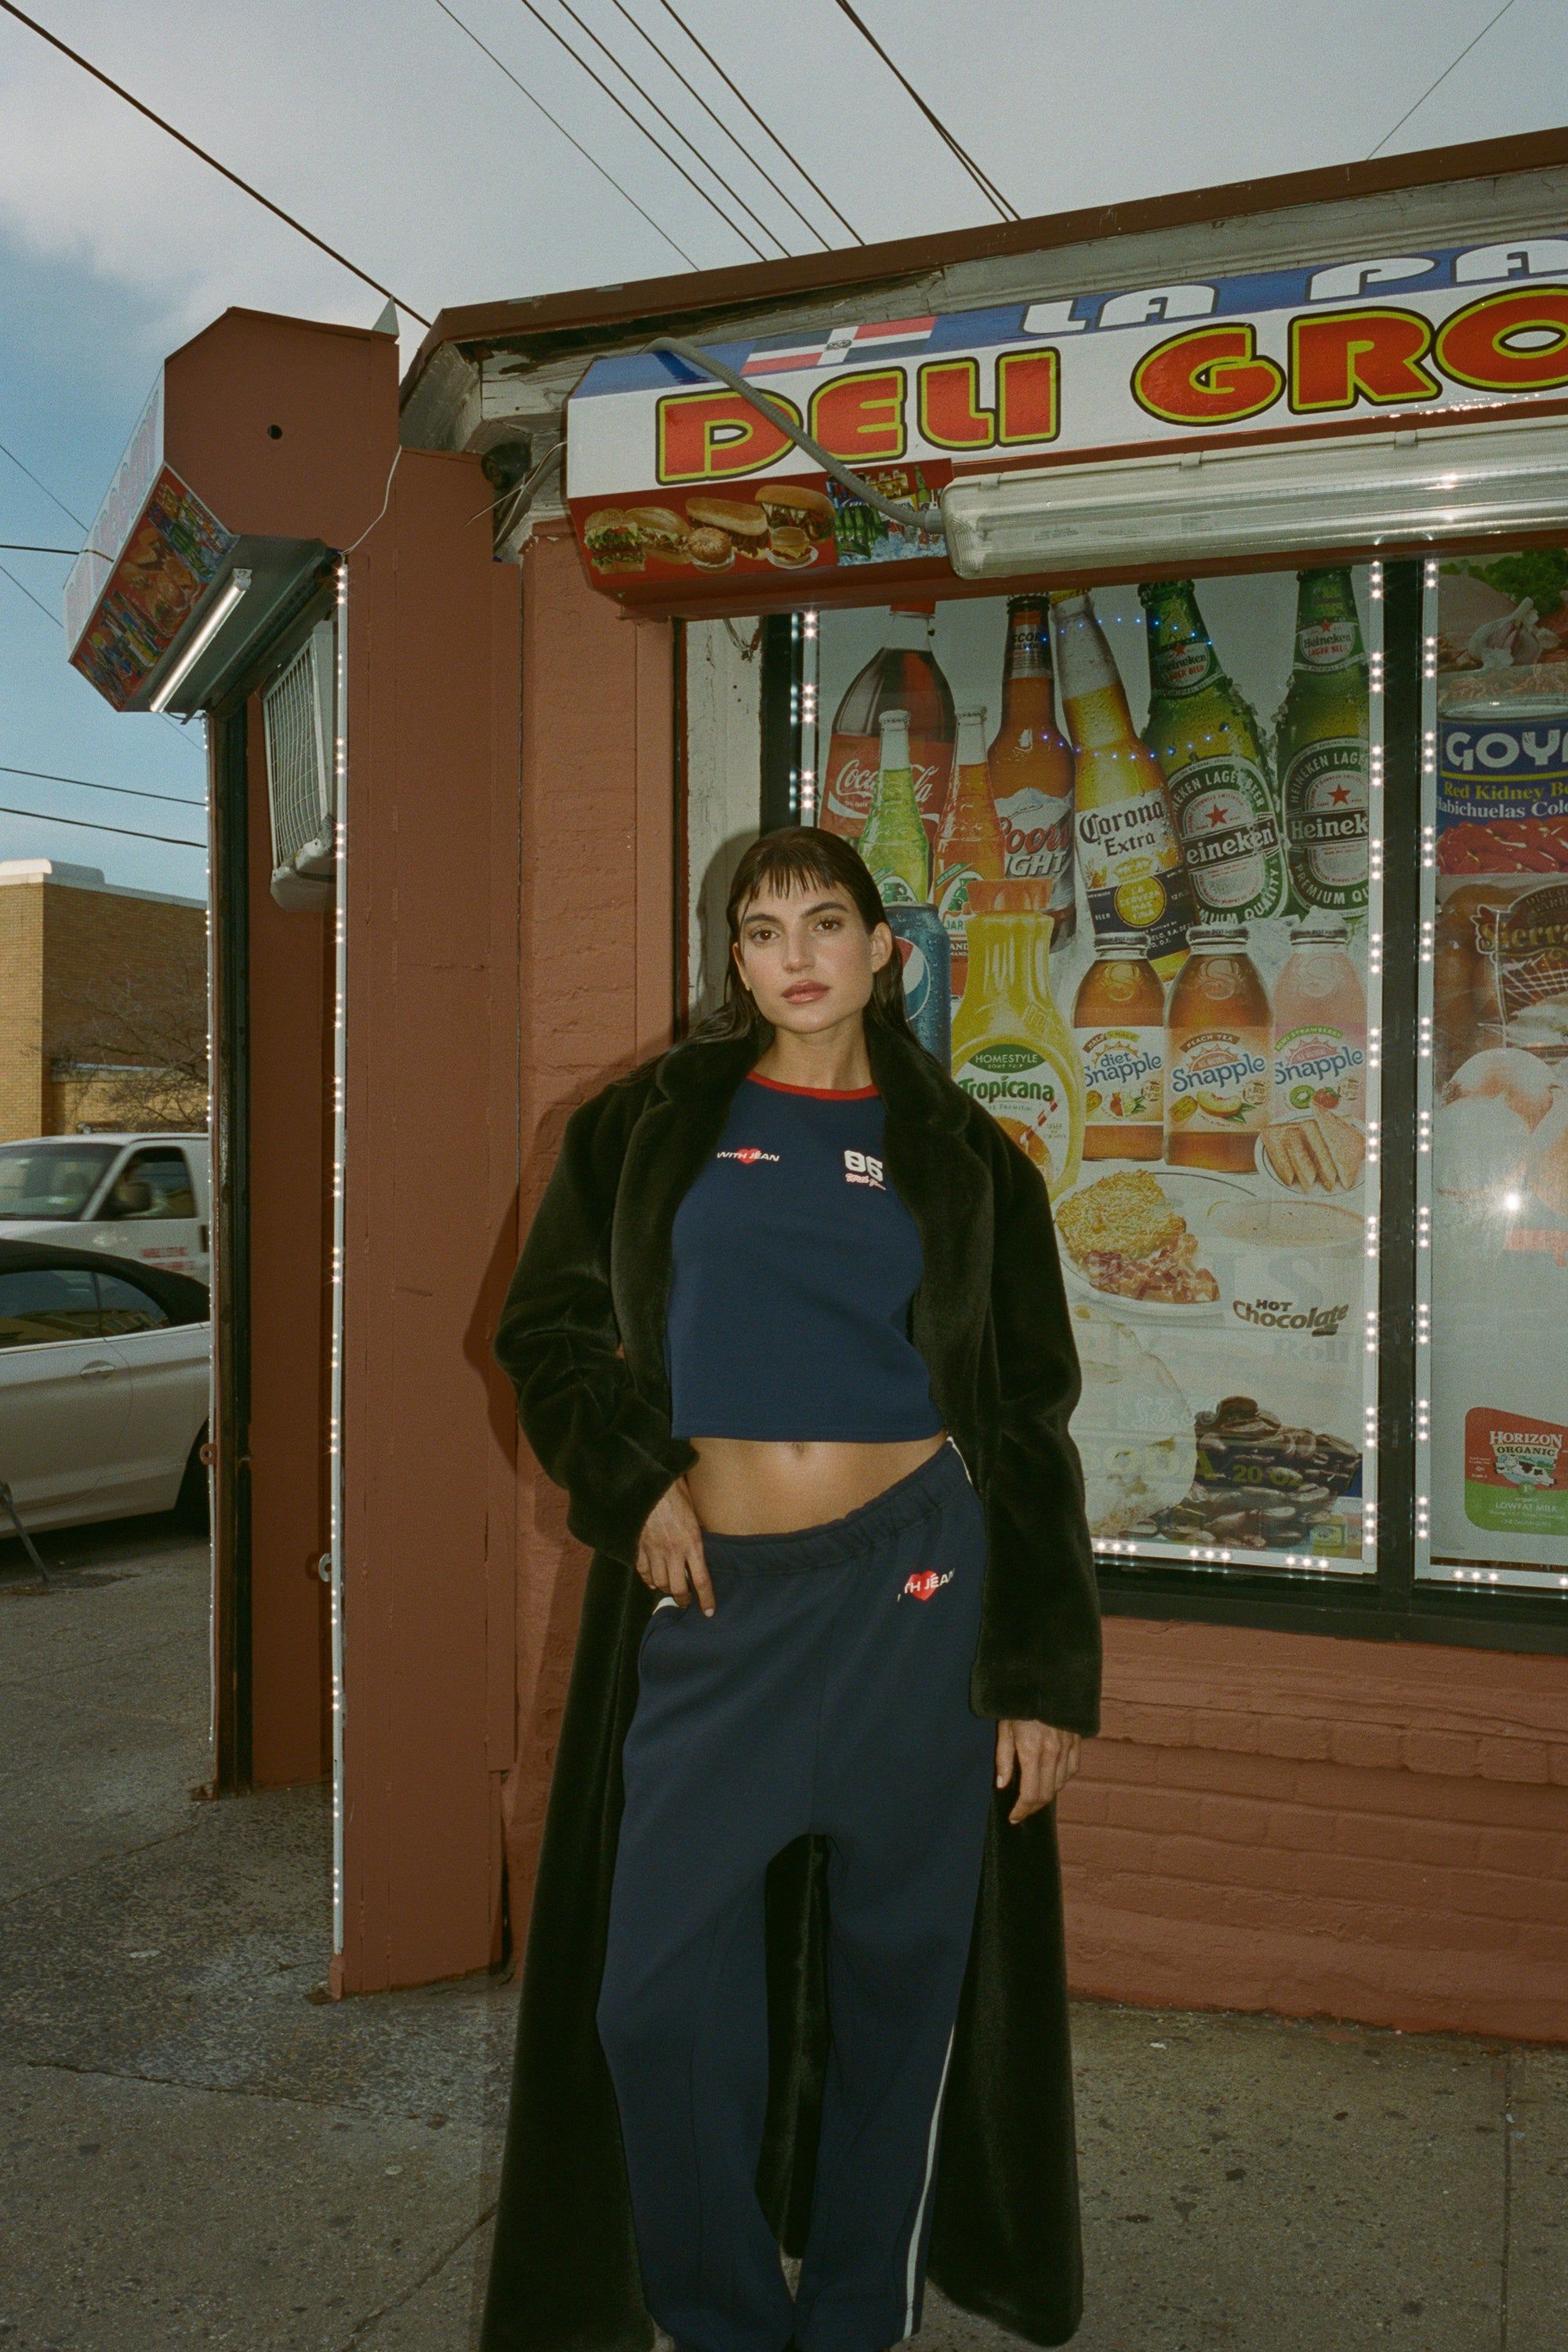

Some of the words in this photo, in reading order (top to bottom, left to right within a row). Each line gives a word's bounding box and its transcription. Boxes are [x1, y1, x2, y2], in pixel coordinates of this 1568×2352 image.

[1022, 284, 1217, 336] LA
[655, 347, 1061, 485] DELI
[1130, 283, 1568, 428] GRO
[1446, 729, 1568, 771] GOY
[1444, 782, 1470, 799] Red
[1475, 785, 1544, 804] Kidney
[1079, 801, 1164, 844] Corona
[1104, 832, 1156, 858] Extra
[1186, 1033, 1214, 1048] PEACH
[1216, 1033, 1234, 1043] TEA
[975, 1054, 1039, 1064] HOMESTYLE
[1100, 1052, 1132, 1067] diet
[1275, 1046, 1364, 1086] Snapple
[1172, 1053, 1266, 1093] Snapple
[1256, 1298, 1293, 1312] HOT
[1232, 1299, 1350, 1338] Chocolate
[1490, 1430, 1564, 1448] HORIZON
[1496, 1446, 1556, 1457] ORGANIC
